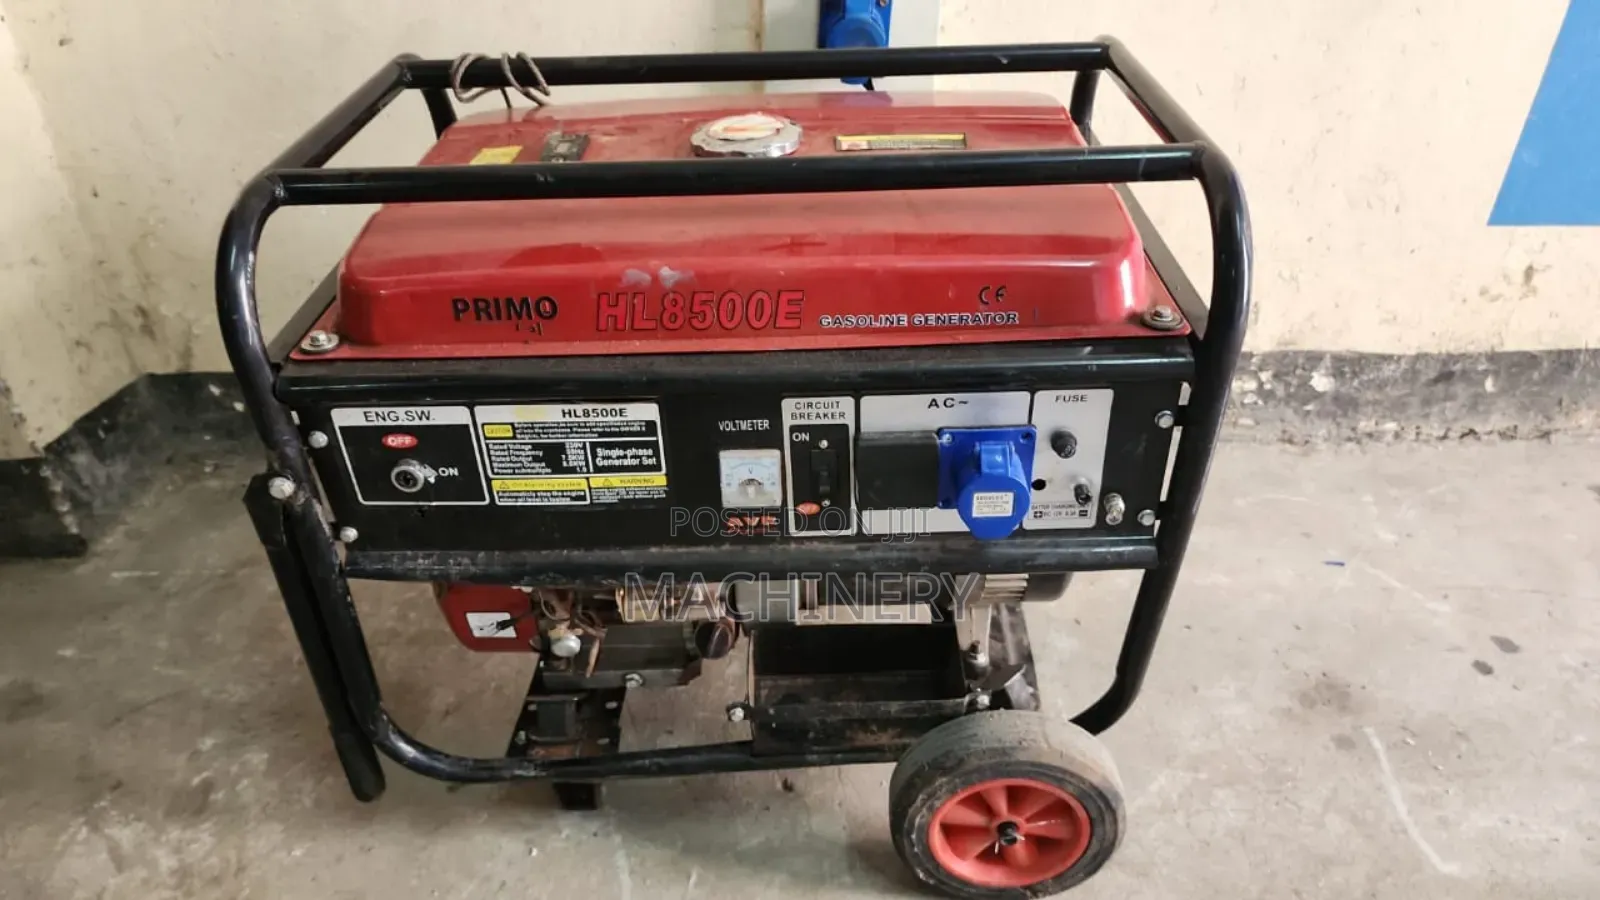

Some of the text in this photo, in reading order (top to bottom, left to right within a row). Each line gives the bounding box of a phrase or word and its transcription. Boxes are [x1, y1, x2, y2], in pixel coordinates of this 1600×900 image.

[451, 296, 558, 321] PRIMO
[596, 289, 805, 332] HL8500E
[819, 312, 1019, 328] GASOLINE GENERATOR
[1055, 394, 1088, 403] FUSE
[794, 401, 841, 410] CIRCUIT
[363, 410, 436, 422] ENG.SW.
[561, 408, 628, 418] HL8500E
[790, 411, 846, 420] BREAKER
[718, 419, 770, 431] VOLTMETER
[387, 437, 412, 446] OFF
[792, 432, 810, 441] ON
[508, 443, 533, 451] Voltage
[510, 449, 543, 457] Frequency
[596, 446, 653, 459] Single-phase
[595, 456, 657, 466] Generator Set
[438, 467, 459, 477] ON
